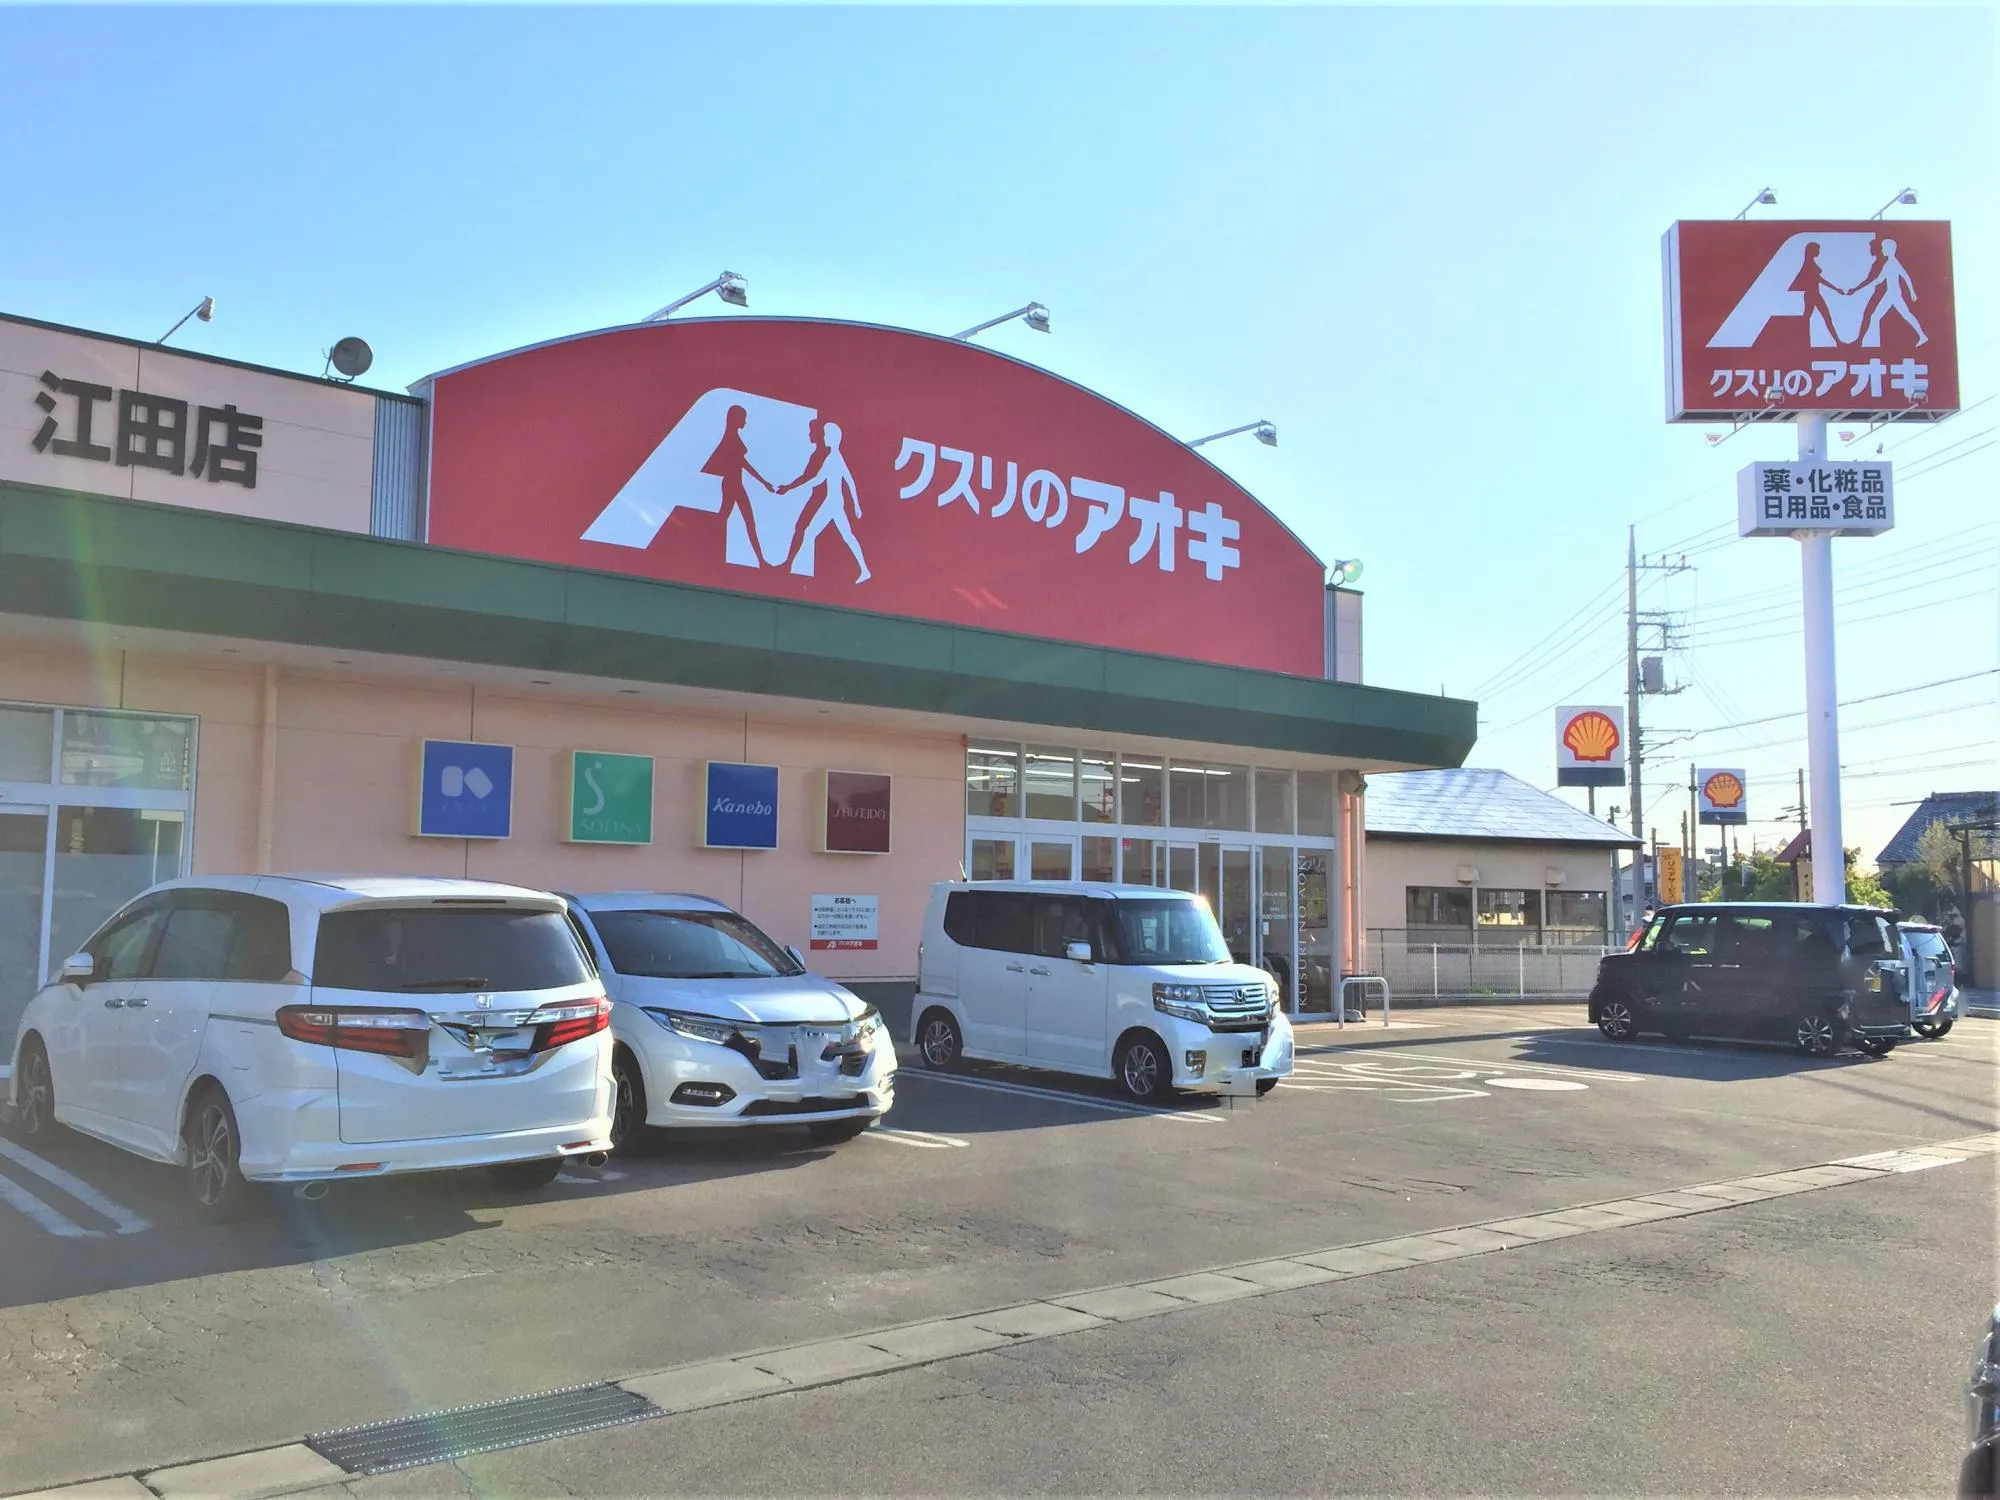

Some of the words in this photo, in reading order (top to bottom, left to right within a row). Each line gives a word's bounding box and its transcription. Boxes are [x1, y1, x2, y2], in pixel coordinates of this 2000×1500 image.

[1710, 358, 1929, 397] クスリのアオキ
[32, 370, 263, 489] 江田店
[1763, 468, 1885, 494] 薬・化粧品
[895, 436, 1241, 581] クスリのアオキ
[1763, 495, 1887, 519] 日用品・食品
[712, 797, 772, 816] Kanebo
[833, 807, 887, 821] SHISEIDO
[1299, 941, 1308, 1006] KUSURI
